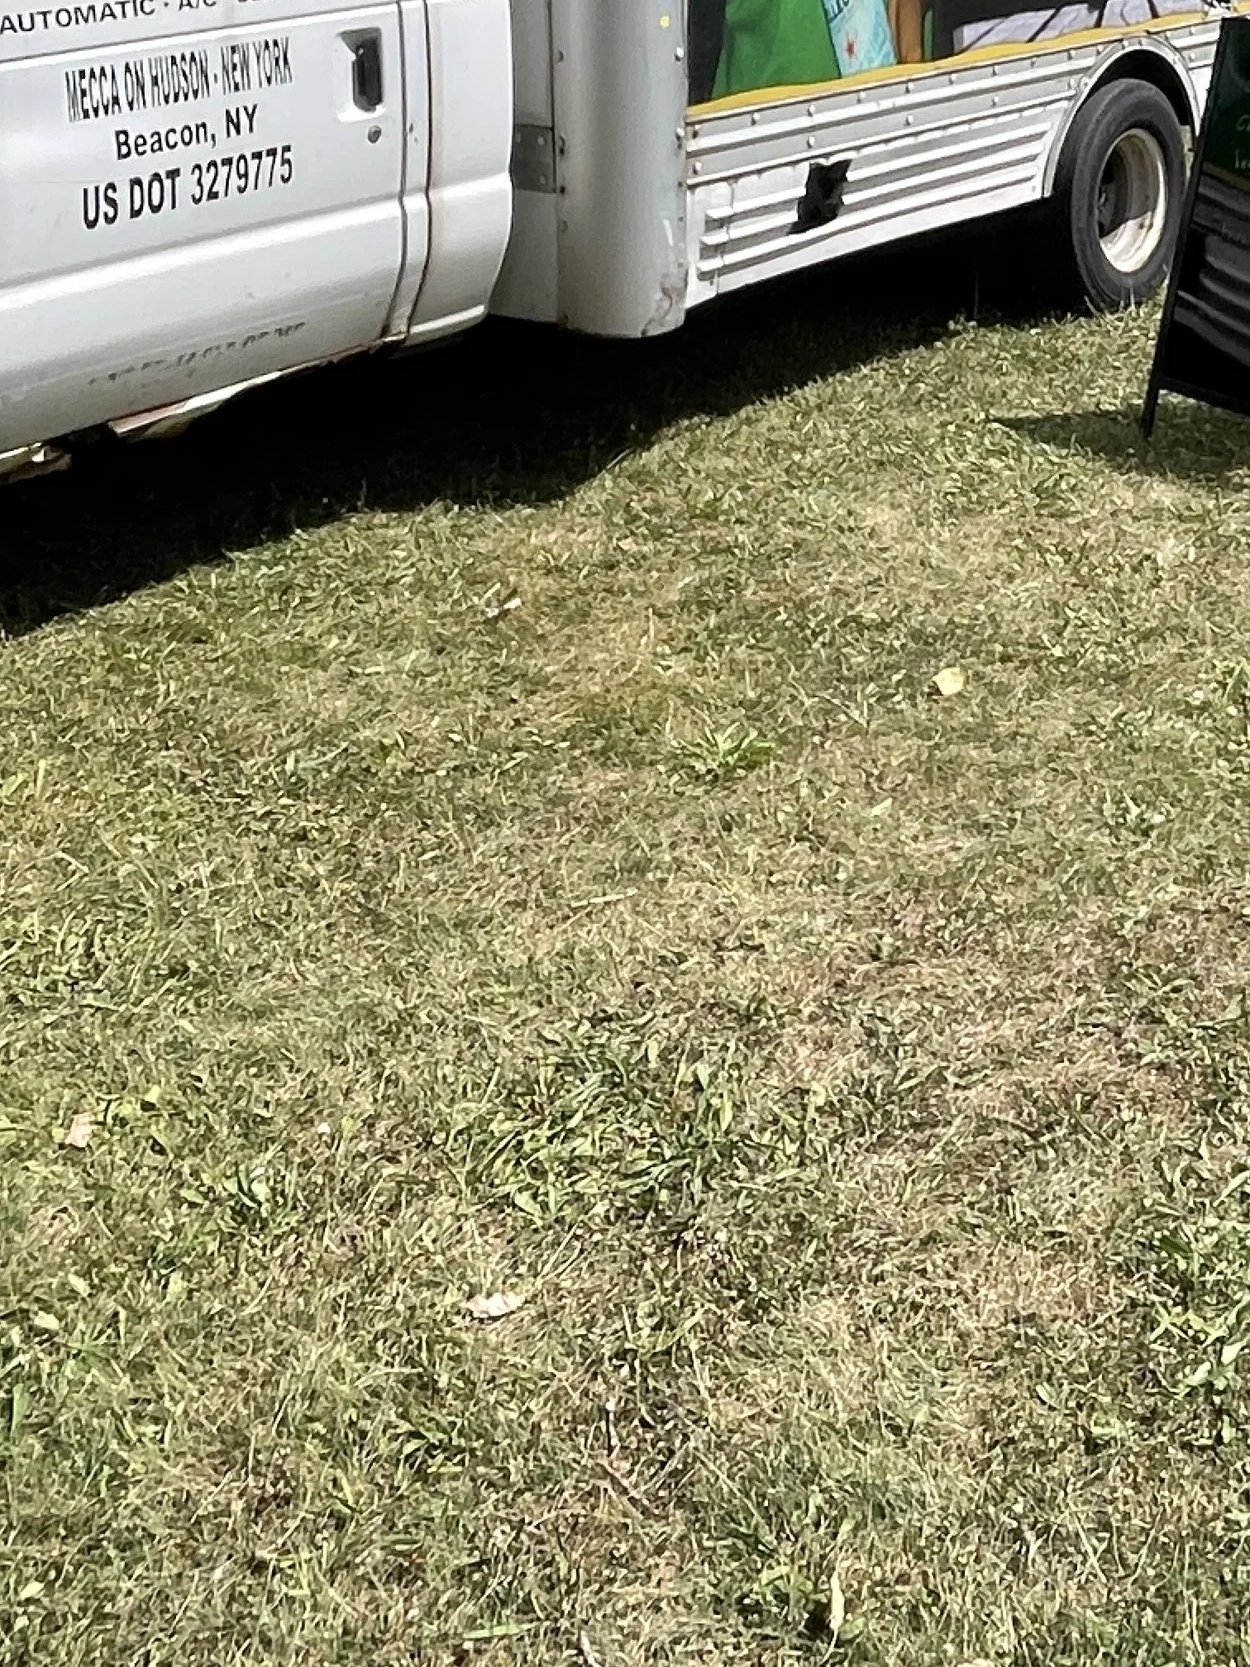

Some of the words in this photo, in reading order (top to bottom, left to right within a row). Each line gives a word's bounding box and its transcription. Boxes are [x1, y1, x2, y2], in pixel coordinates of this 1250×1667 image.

[65, 64, 122, 122] MECCA
[124, 63, 147, 114] ON
[150, 49, 211, 108] HUDSON
[221, 42, 252, 96] NEW
[254, 36, 293, 88] YORK
[114, 121, 217, 161] Beacon,
[225, 103, 259, 136] NY
[83, 182, 119, 230] US
[128, 167, 181, 220] DOT
[190, 144, 293, 205] 3279775
